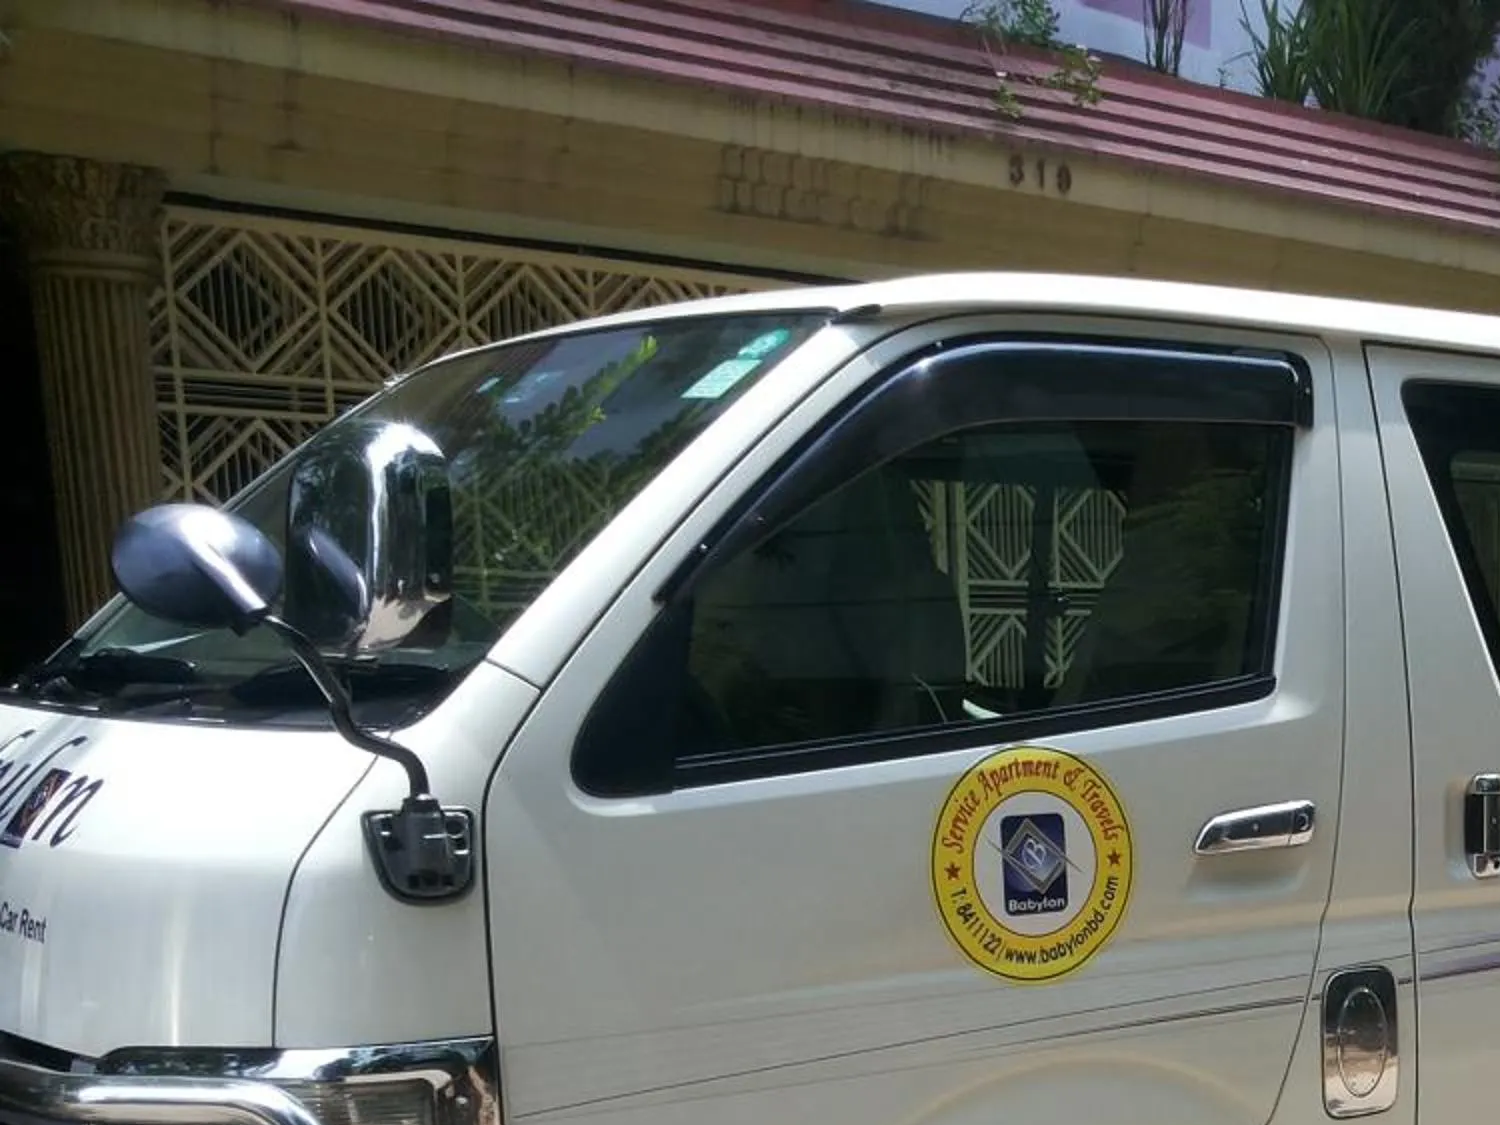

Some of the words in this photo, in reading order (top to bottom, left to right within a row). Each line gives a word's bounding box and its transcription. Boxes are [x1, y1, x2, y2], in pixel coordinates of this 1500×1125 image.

[941, 788, 981, 854] Service
[977, 757, 1060, 800] Apartment
[1079, 778, 1124, 841] Travels
[1008, 896, 1065, 913] Babylon
[19, 909, 47, 945] Rent
